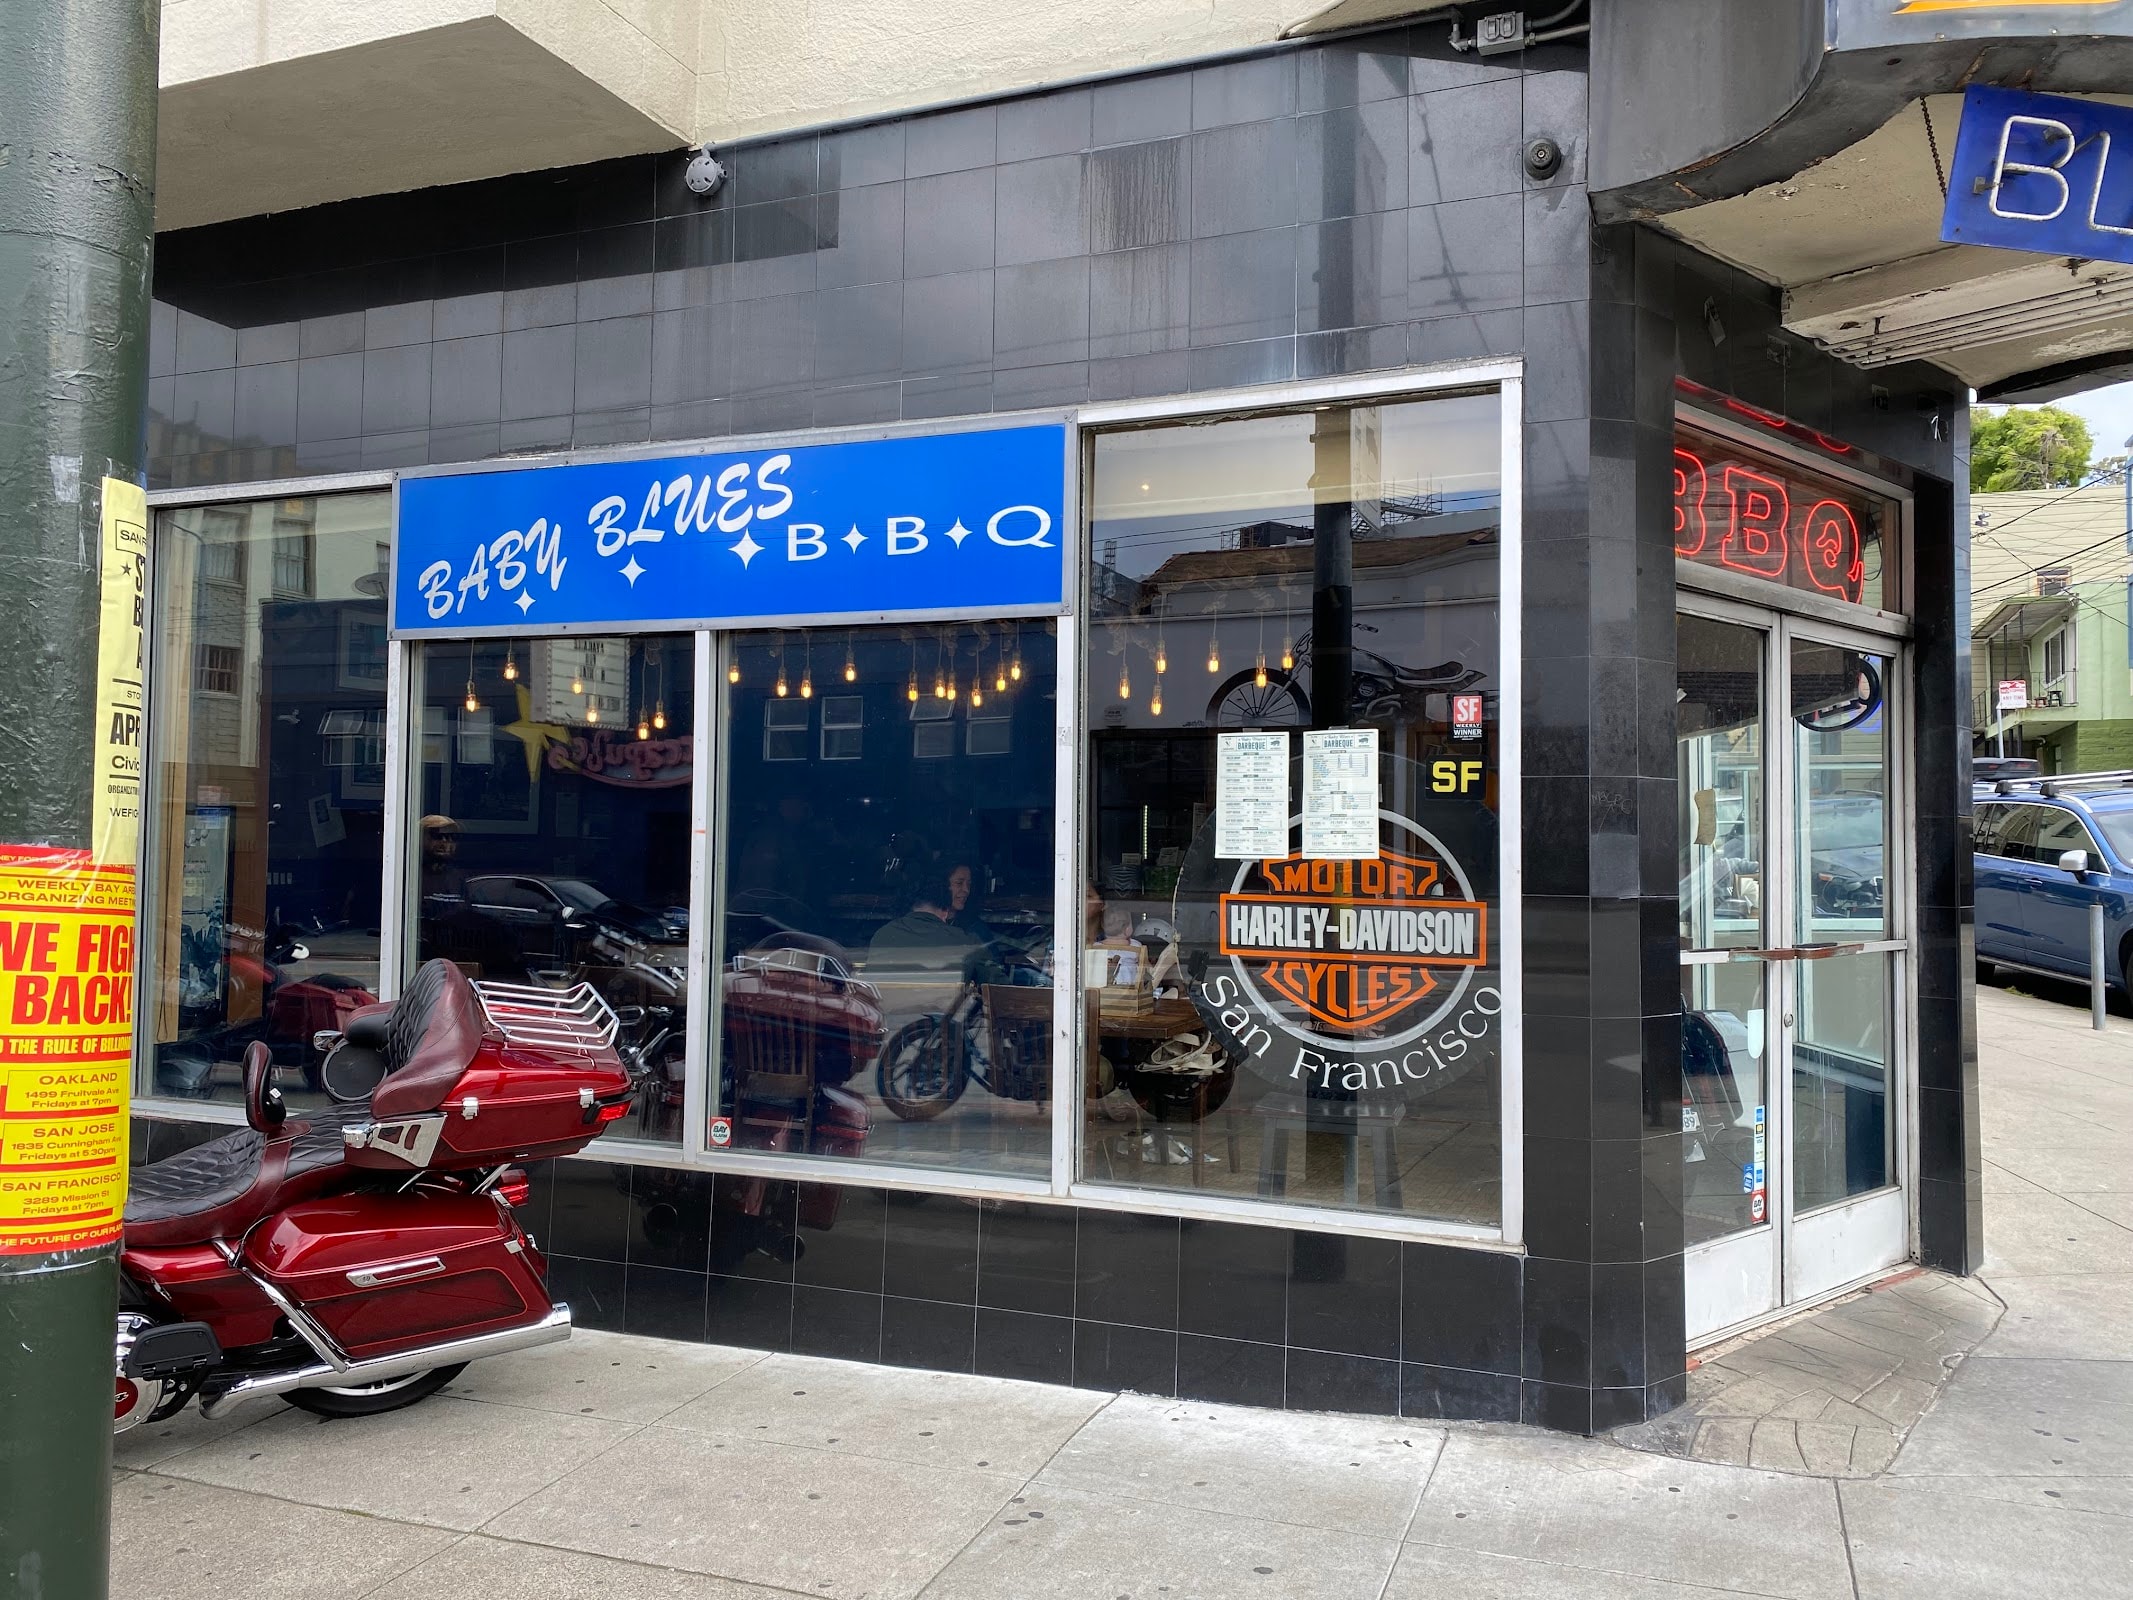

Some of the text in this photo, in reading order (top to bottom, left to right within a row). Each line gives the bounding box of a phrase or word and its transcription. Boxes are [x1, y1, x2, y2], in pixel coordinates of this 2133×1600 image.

[418, 455, 794, 620] BABY BLUES
[1456, 698, 1479, 722] SF
[1453, 728, 1482, 736] WINNER
[1237, 741, 1266, 751] BARBEQUE
[1324, 739, 1353, 749] BARBEQUE
[111, 755, 140, 771] Civic
[1432, 760, 1483, 793] SF
[1283, 858, 1415, 896] MOTOR
[17, 879, 90, 891] WEEKLY
[95, 883, 120, 893] BAY
[0, 891, 105, 905] ORGANIZING
[1229, 904, 1475, 956] HARLEY-DAVIDSON
[1283, 961, 1413, 1019] CYCLES
[11, 975, 133, 1026] BACK!
[1201, 974, 1503, 1091] San Francisco
[9, 1038, 38, 1055] THE
[42, 1038, 79, 1055] RULE
[82, 1037, 98, 1053] OF
[39, 1072, 118, 1086] OAKLAND
[25, 1087, 120, 1099] 1499 Fruitvale Ave
[31, 1100, 77, 1109] Fridays
[92, 1098, 112, 1106] 7pm
[33, 1123, 115, 1138] SAN JOSE
[712, 1125, 728, 1133] BAY
[11, 1142, 44, 1151] 1835
[46, 1137, 111, 1150] Cunningham
[19, 1152, 67, 1161] Fridays
[69, 1150, 80, 1158] at
[2, 1172, 121, 1192] SAN FRANCISCO
[23, 1196, 60, 1205] 3289
[62, 1192, 100, 1203] Mission
[22, 1205, 69, 1215] Fridays
[84, 1201, 104, 1210] 7pm
[20, 1234, 71, 1246] FUTURE
[73, 1231, 88, 1240] OF
[89, 1226, 109, 1239] OUR
